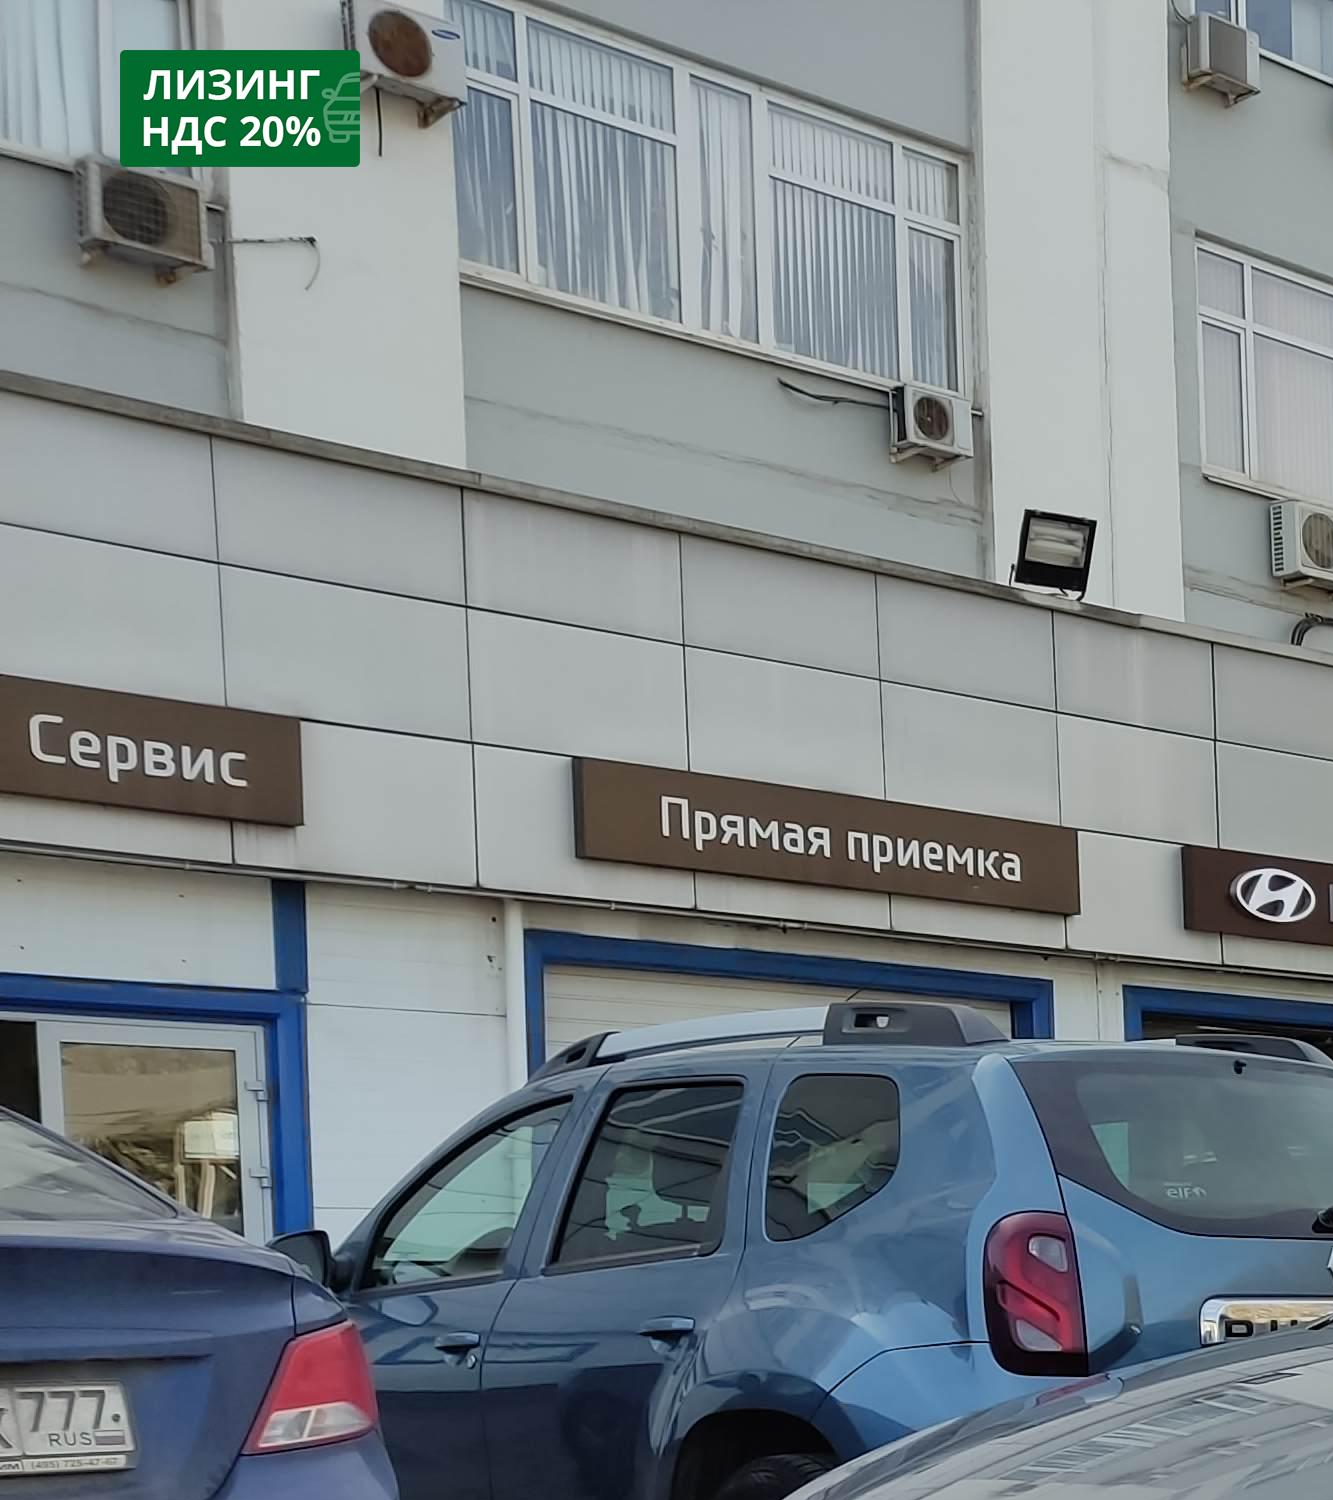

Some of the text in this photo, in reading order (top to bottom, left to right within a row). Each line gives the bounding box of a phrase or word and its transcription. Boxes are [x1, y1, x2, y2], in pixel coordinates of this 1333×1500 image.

[28, 713, 248, 787] Сервис
[660, 795, 1022, 882] Прямая приемка
[16, 1390, 105, 1432] 777
[48, 1432, 93, 1446] RUS
